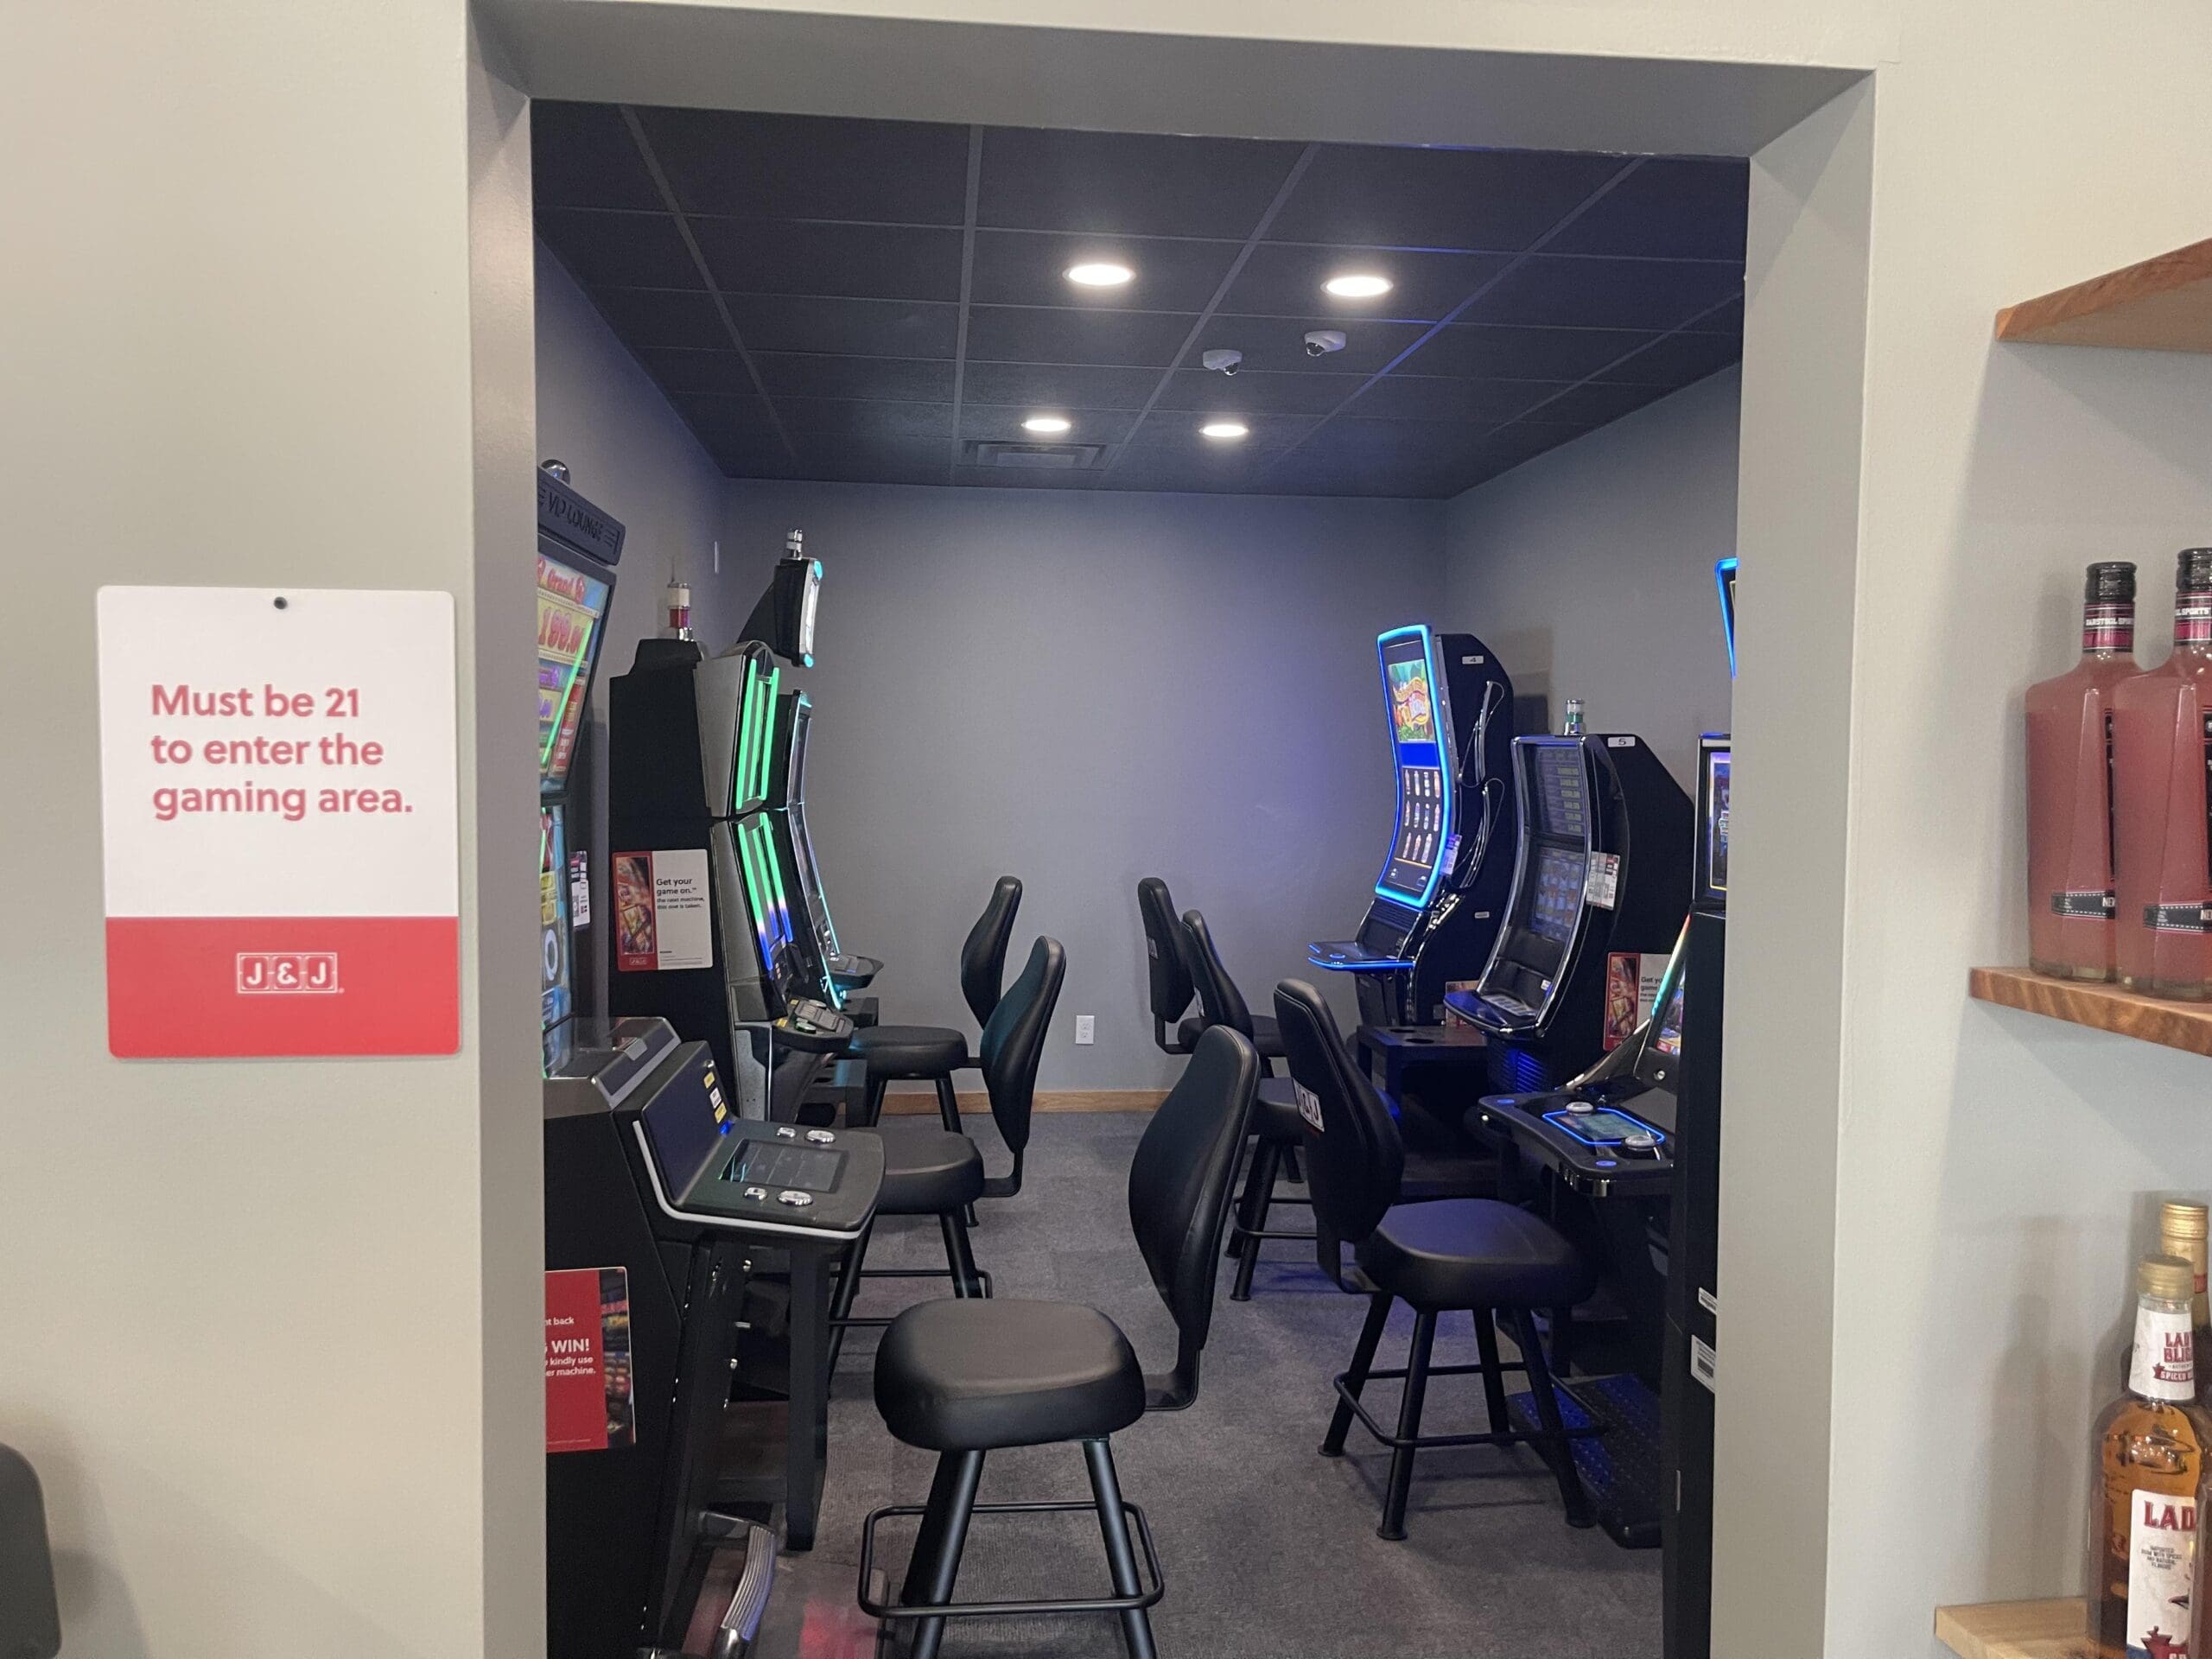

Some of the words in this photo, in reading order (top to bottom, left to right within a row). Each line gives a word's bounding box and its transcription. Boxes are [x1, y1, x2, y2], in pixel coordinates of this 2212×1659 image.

[150, 683, 253, 716] Must
[264, 684, 315, 718] be
[325, 688, 359, 718] 21
[150, 734, 193, 765] to
[204, 738, 310, 766] enter
[321, 733, 385, 766] the
[153, 781, 306, 821] gaming
[318, 788, 413, 814] area.
[673, 878, 693, 887] your
[244, 960, 329, 988] J&J
[553, 1317, 575, 1325] back
[551, 1338, 590, 1353] WIN!
[2164, 1332, 2193, 1348] LAD
[550, 1357, 576, 1367] kindly
[556, 1366, 596, 1376] machine.
[2160, 1370, 2187, 1381] SPICED
[2143, 1500, 2196, 1532] LAD
